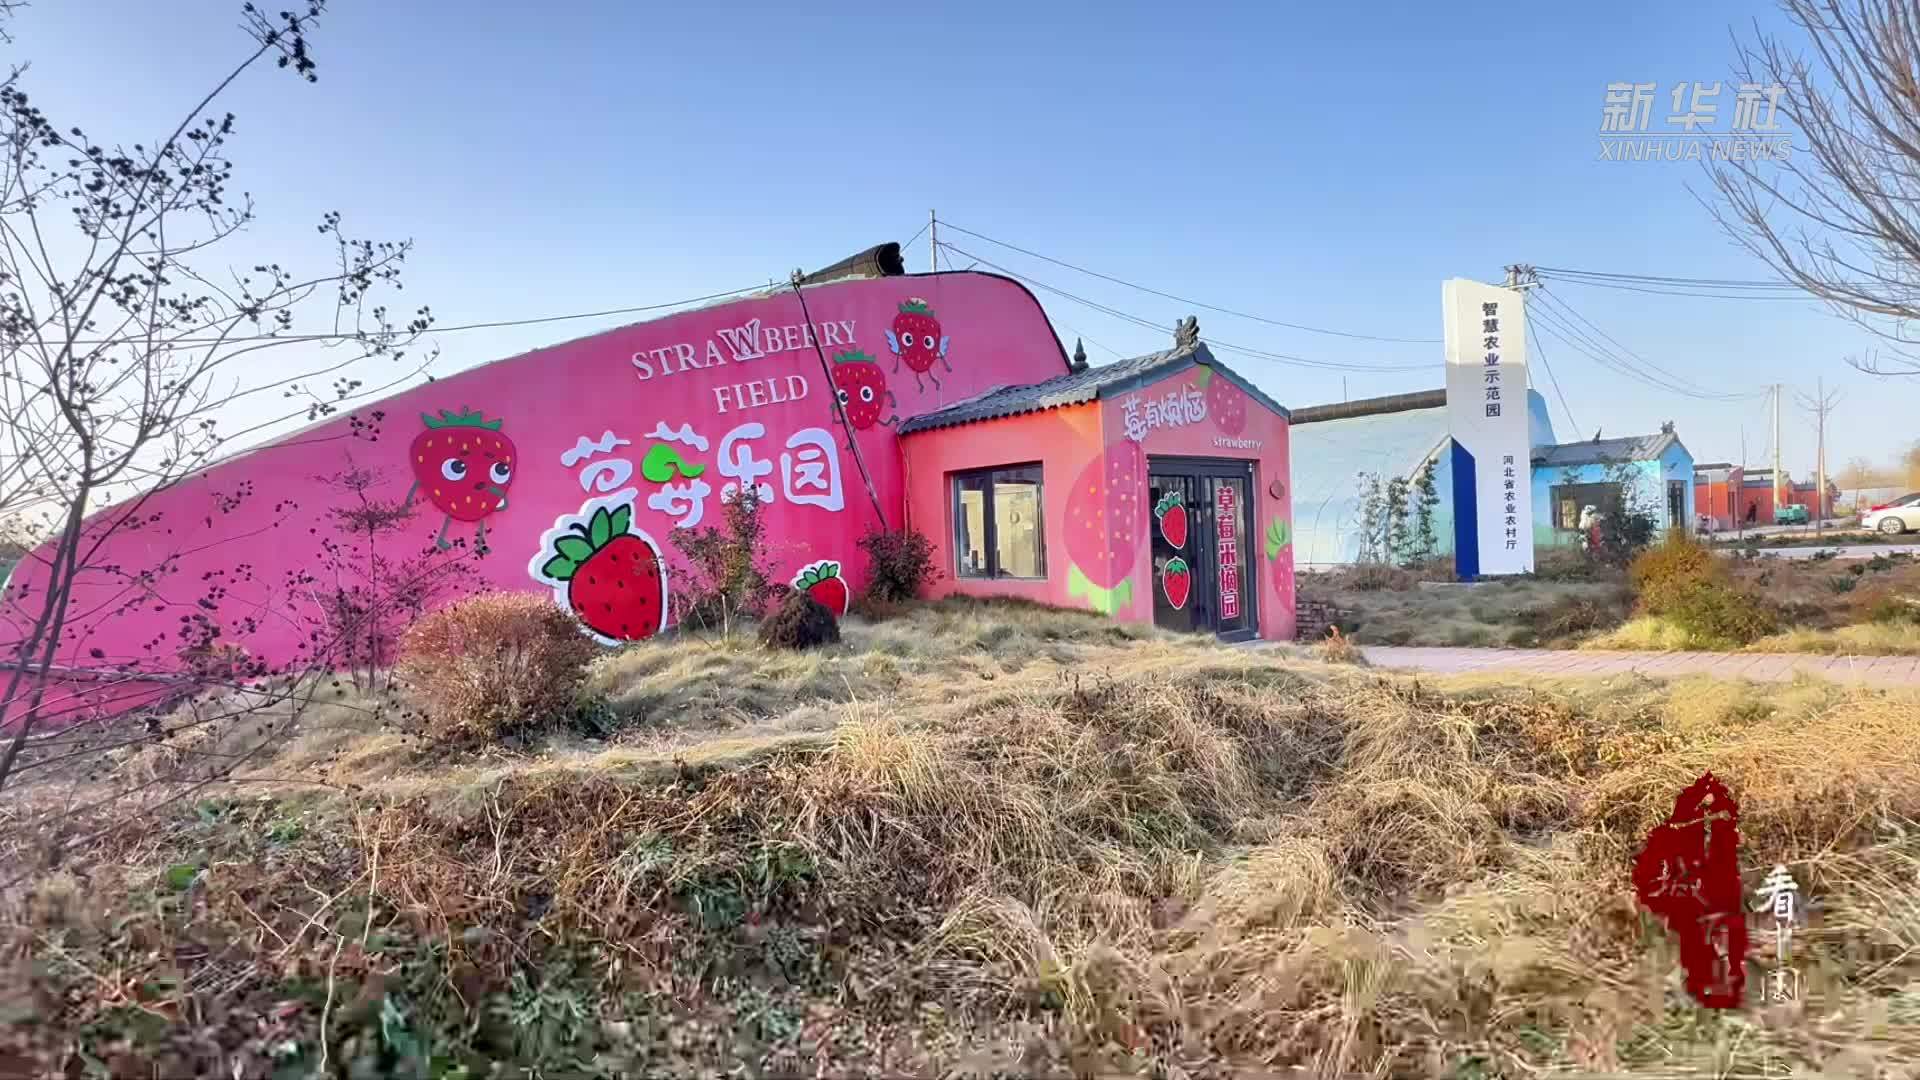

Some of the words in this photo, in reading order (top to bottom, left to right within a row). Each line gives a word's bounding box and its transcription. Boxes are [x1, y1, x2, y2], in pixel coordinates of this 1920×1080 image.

[631, 318, 857, 380] STRAWBERRY
[1482, 302, 1501, 417] 智慧农业示范园
[712, 375, 809, 414] FIELD
[1120, 382, 1208, 443] 莓有烦恼
[1212, 436, 1263, 452] strawberry
[1503, 455, 1518, 550] 河北省农业农村厅
[1216, 486, 1240, 620] 草莓采摘园
